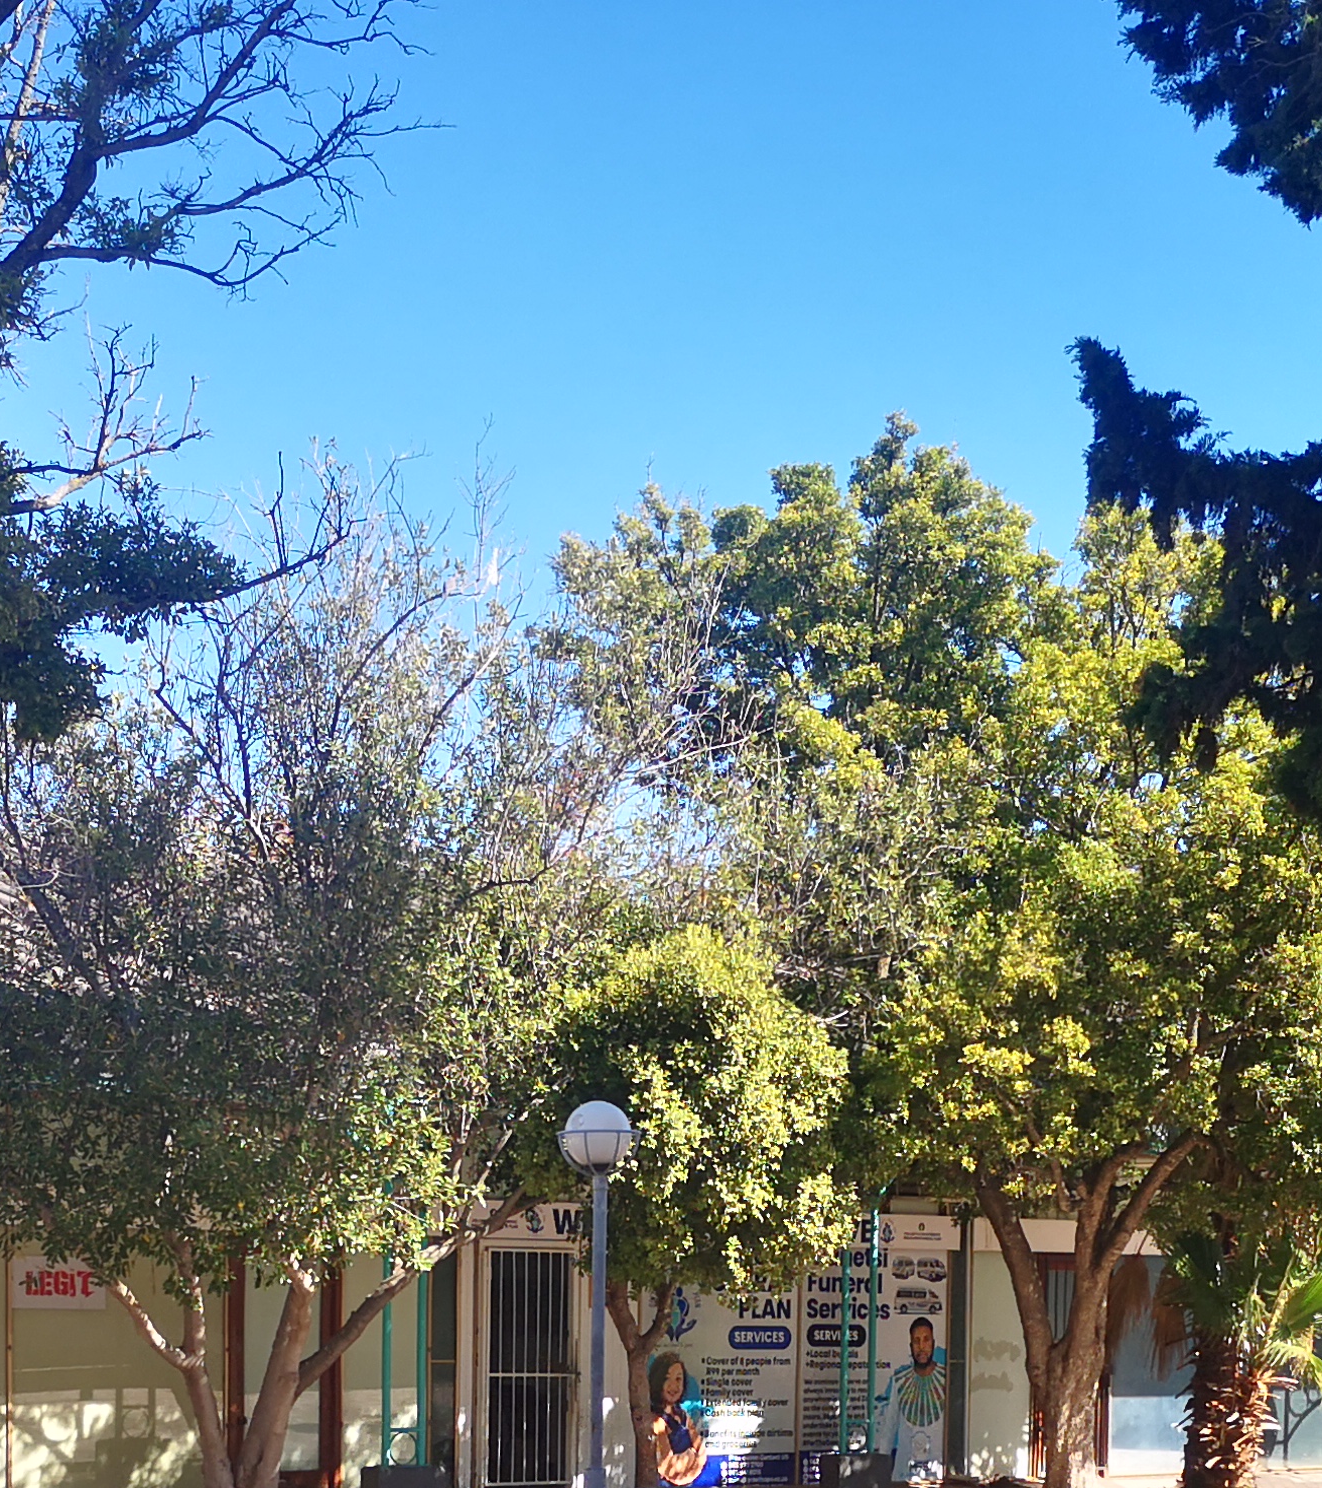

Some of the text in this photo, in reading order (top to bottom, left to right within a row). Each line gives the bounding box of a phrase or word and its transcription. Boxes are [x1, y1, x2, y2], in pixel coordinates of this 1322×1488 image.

[806, 1297, 890, 1320] Serics
[734, 1331, 785, 1343] SERVICES
[813, 1330, 859, 1341] SERVIES
